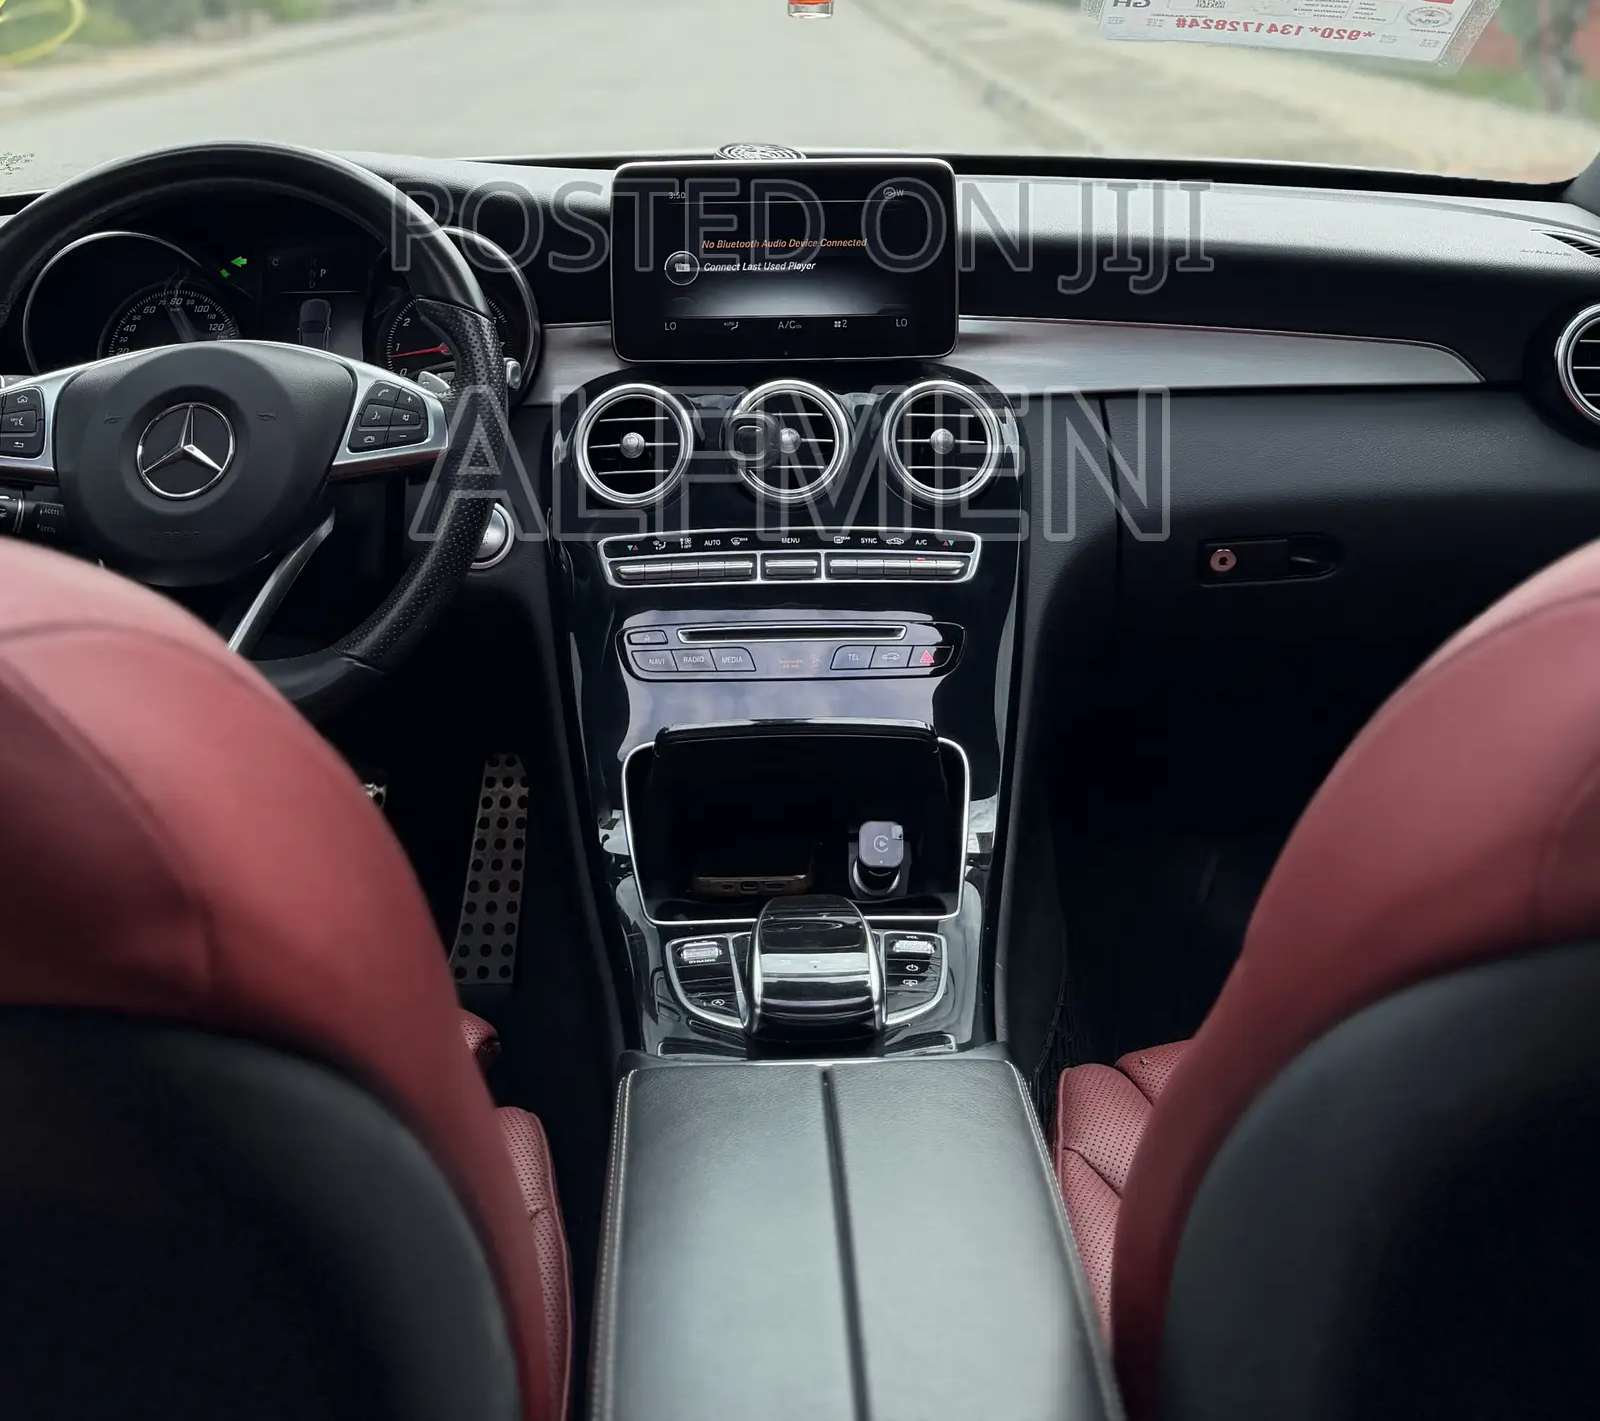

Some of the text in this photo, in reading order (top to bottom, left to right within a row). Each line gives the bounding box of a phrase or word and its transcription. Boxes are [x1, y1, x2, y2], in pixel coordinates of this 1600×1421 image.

[668, 190, 687, 201] 3:50
[701, 237, 869, 250] No Bluetooth Audio Device Connected
[703, 260, 817, 274] Connect Last Used Player
[320, 268, 327, 278] P
[169, 297, 183, 306] 80
[142, 305, 157, 315] 60
[193, 305, 210, 314] 100
[402, 317, 412, 327] 2
[664, 321, 677, 331] LO
[895, 317, 908, 327] LO
[122, 324, 137, 333] 40
[208, 323, 226, 332] 120
[394, 342, 401, 352] 1
[400, 367, 408, 377] 0
[703, 539, 721, 547] AUTO
[781, 537, 800, 545] MENU
[860, 537, 878, 545] SYNC
[648, 658, 666, 666] NAVI
[683, 656, 706, 664] RADIO
[721, 656, 744, 664] MEDIA
[848, 653, 860, 662] TEL
